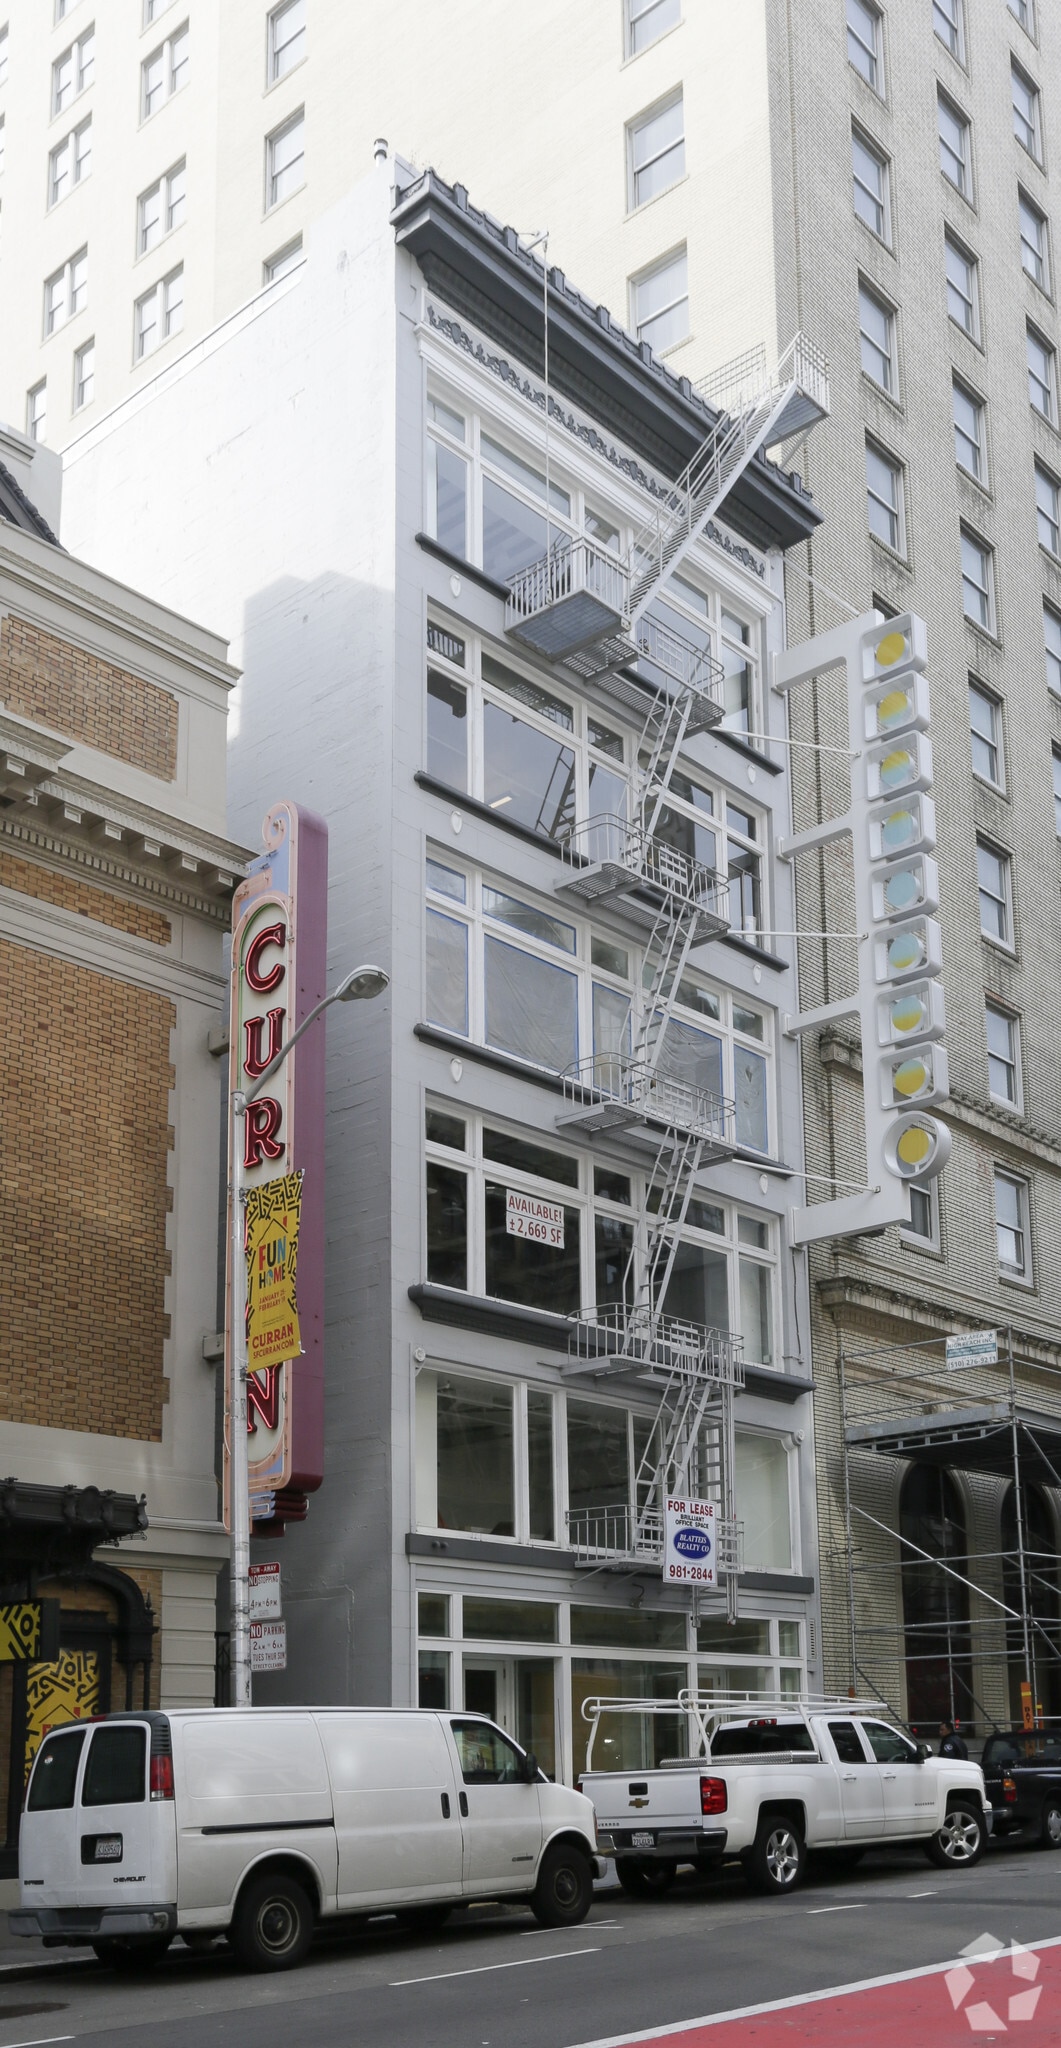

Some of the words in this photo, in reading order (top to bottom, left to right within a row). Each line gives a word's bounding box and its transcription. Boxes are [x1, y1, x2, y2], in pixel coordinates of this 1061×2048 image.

[244, 922, 286, 1432] CURN
[508, 1195, 562, 1224] AVAILABLE!
[550, 1228, 562, 1244] SF
[258, 1235, 286, 1271] FUN
[259, 1263, 285, 1289] HOME
[259, 1292, 280, 1305] JANUARY
[259, 1299, 281, 1312] FEBRUARY
[252, 1322, 294, 1349] CURRAN
[253, 1338, 295, 1359] SFCURRAN.COM
[948, 1360, 965, 1370] (510)
[668, 1500, 686, 1513] FOR
[690, 1503, 713, 1516] LEASE
[675, 1519, 693, 1527] OFFICE
[680, 1514, 705, 1522] BRILLIANT
[679, 1534, 707, 1543] BLATTEIS
[677, 1542, 700, 1551] REALTY
[249, 1575, 258, 1586] NO
[258, 1574, 279, 1585] STOPPING
[250, 1624, 262, 1638] NO
[263, 1624, 285, 1636] PARKING
[253, 1653, 265, 1662] TUES
